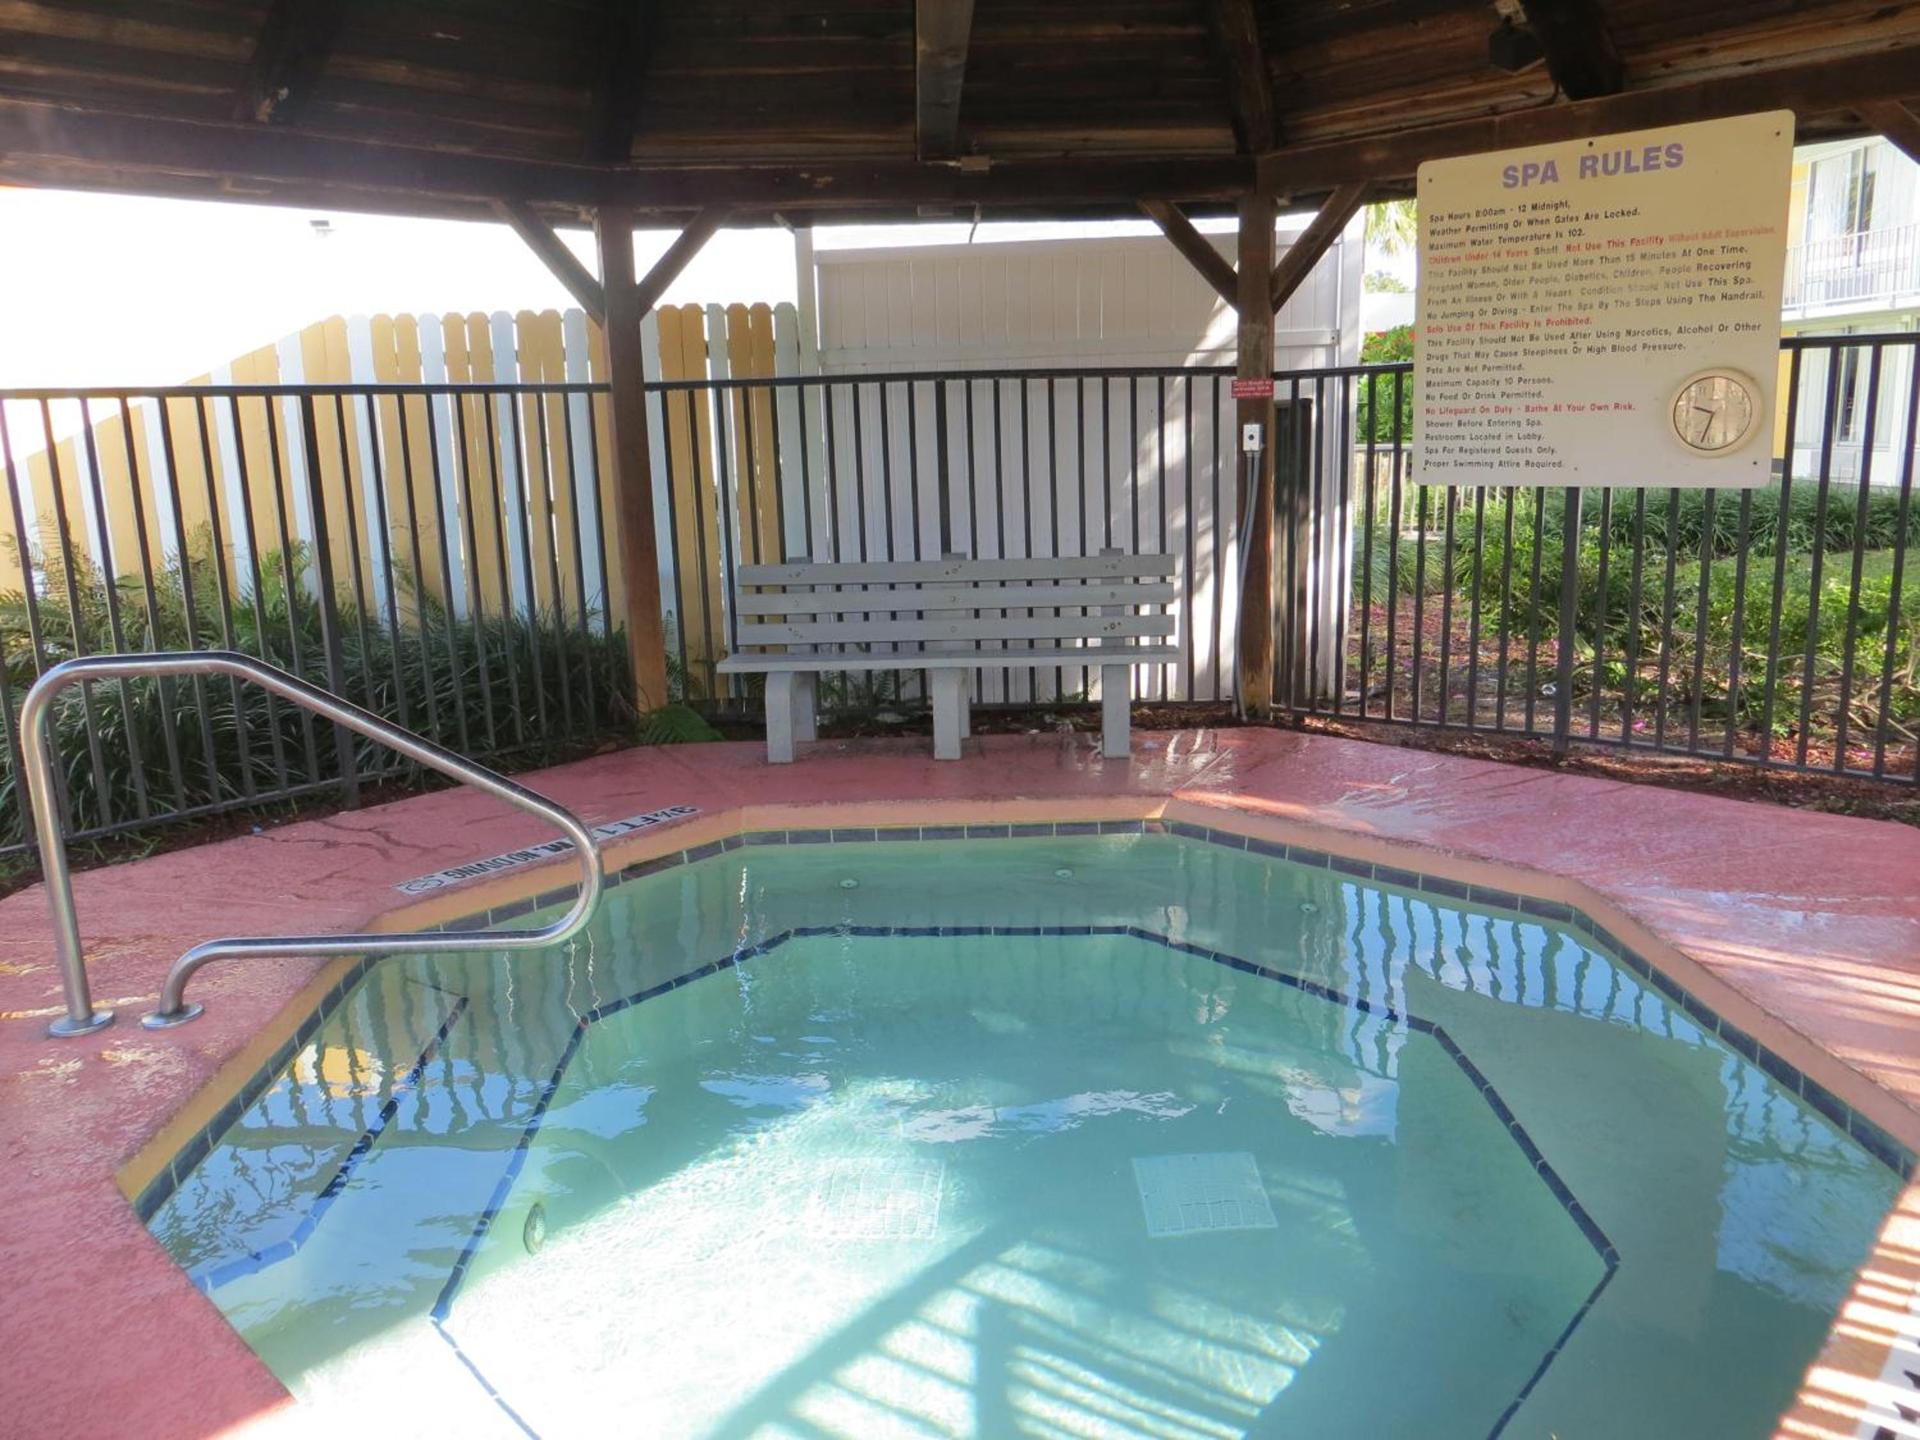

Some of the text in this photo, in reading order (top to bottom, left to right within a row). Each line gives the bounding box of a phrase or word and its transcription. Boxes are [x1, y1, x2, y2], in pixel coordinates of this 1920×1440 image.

[1502, 143, 1684, 189] SPA RULES
[1429, 214, 1444, 223] Spa
[1448, 212, 1470, 220] Hours
[1430, 208, 1640, 236] Weather Permitting Or When Gates Are Locked.
[1429, 241, 1465, 250] Maximum
[1498, 232, 1551, 244] Temperature
[1568, 228, 1584, 237] 102.
[1429, 255, 1461, 264] Children
[1465, 253, 1488, 261] Under
[1566, 244, 1581, 252] Not
[1585, 242, 1601, 250] Use
[1608, 240, 1624, 248] This
[1630, 236, 1664, 247] Facility
[1448, 267, 1476, 277] Facility
[1482, 264, 1509, 273] Should
[1532, 261, 1542, 269] Be
[1547, 260, 1568, 268] Used
[1573, 258, 1594, 266] More
[1600, 255, 1621, 264] Than
[1640, 251, 1676, 260] Minutes
[1697, 248, 1714, 256] One
[1721, 245, 1747, 254] Time.
[1503, 278, 1524, 286] Older
[1697, 260, 1751, 271] Recovering
[1685, 280, 1701, 288] Use
[1708, 277, 1727, 286] This
[1441, 310, 1474, 318] Jumping
[1492, 307, 1518, 316] Diving
[1530, 304, 1552, 313] Enter
[1578, 302, 1593, 310] Spa
[1599, 302, 1608, 310] By
[1614, 299, 1631, 308] The
[1635, 297, 1660, 307] Steps
[1666, 296, 1693, 305] Using
[1700, 294, 1715, 302] The
[1479, 321, 1496, 329] This
[1500, 320, 1529, 329] Facility
[1546, 317, 1592, 326] Prohibited.
[1447, 337, 1474, 346] Facility
[1479, 336, 1506, 344] Should
[1570, 331, 1591, 340] After
[1596, 330, 1620, 339] Using
[1626, 327, 1671, 337] Narcotics,
[1677, 324, 1712, 334] Alcohol
[1426, 353, 1448, 361] Drugs
[1475, 351, 1489, 359] May
[1586, 344, 1606, 354] High
[1611, 343, 1637, 352] Blood
[1643, 342, 1685, 350] Pressure.
[1482, 363, 1524, 372] Permitted.
[1426, 380, 1462, 388] Maximum
[1466, 378, 1500, 386] Capacity
[1518, 376, 1554, 384] Persons.
[1501, 391, 1544, 399] Permitted.
[1439, 406, 1475, 416] Lifeguard
[1494, 405, 1512, 414] Duty
[1567, 403, 1584, 411] Your
[1591, 403, 1610, 412] Own
[1615, 402, 1636, 412] Risk.
[1488, 419, 1521, 427] Entering
[1526, 418, 1543, 427] Spa.
[1424, 446, 1439, 454] Spa
[1459, 446, 1500, 455] Registered
[1537, 446, 1557, 455] Only.
[1424, 460, 1449, 469] Proper
[1454, 459, 1493, 469] Swimming
[1498, 460, 1520, 468] Attire
[444, 858, 515, 878] DIVING
